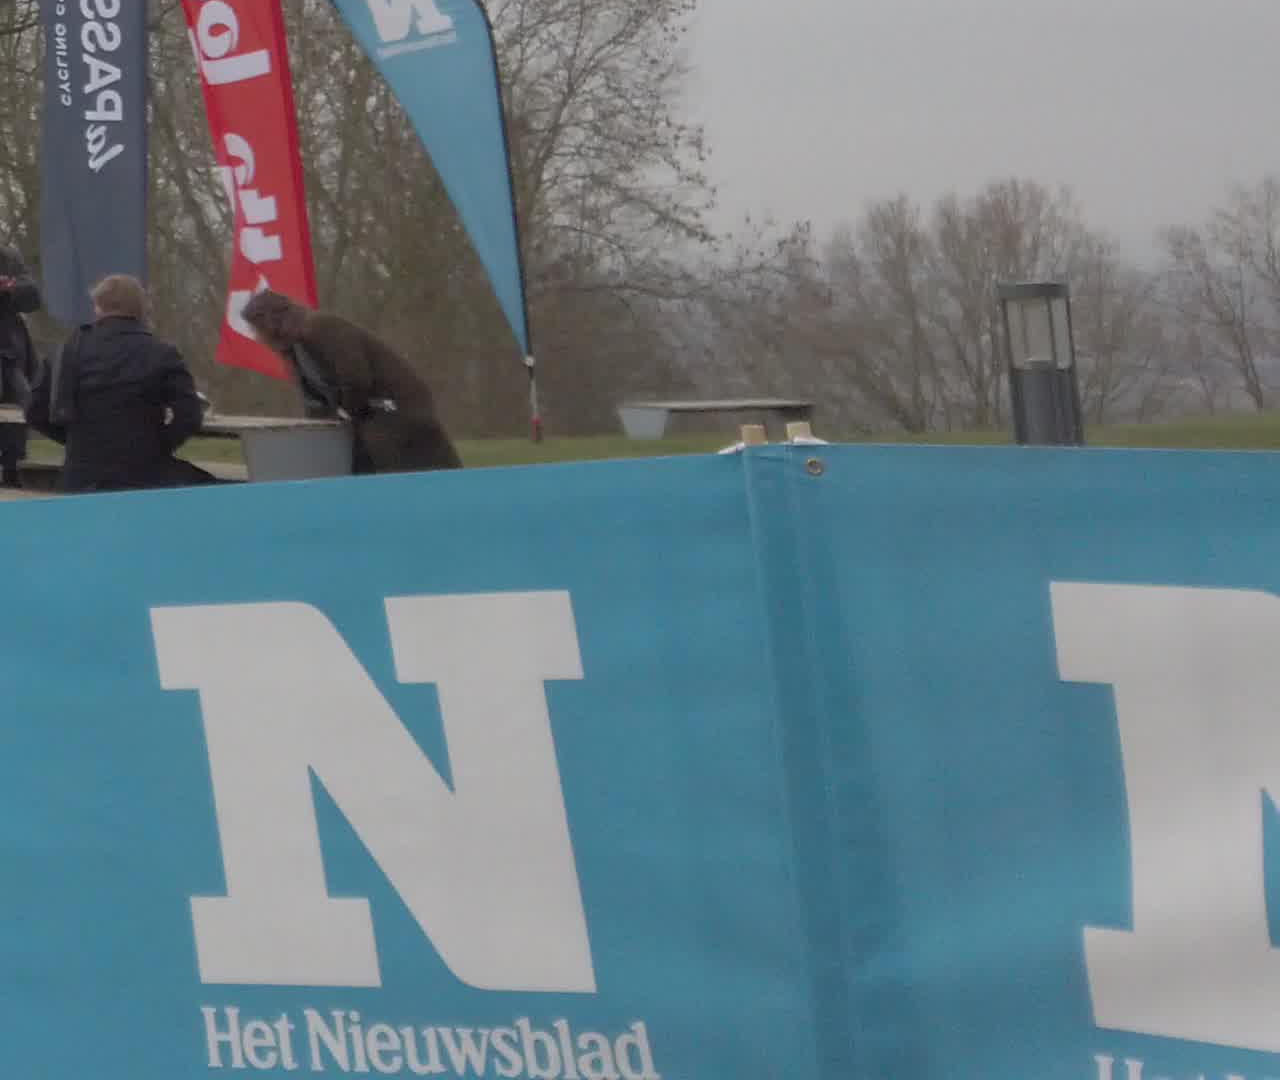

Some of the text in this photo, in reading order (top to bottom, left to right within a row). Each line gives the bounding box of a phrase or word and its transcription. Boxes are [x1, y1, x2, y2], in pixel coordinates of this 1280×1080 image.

[149, 589, 598, 993] N
[200, 1005, 661, 1080] Het Nieuwsblad
